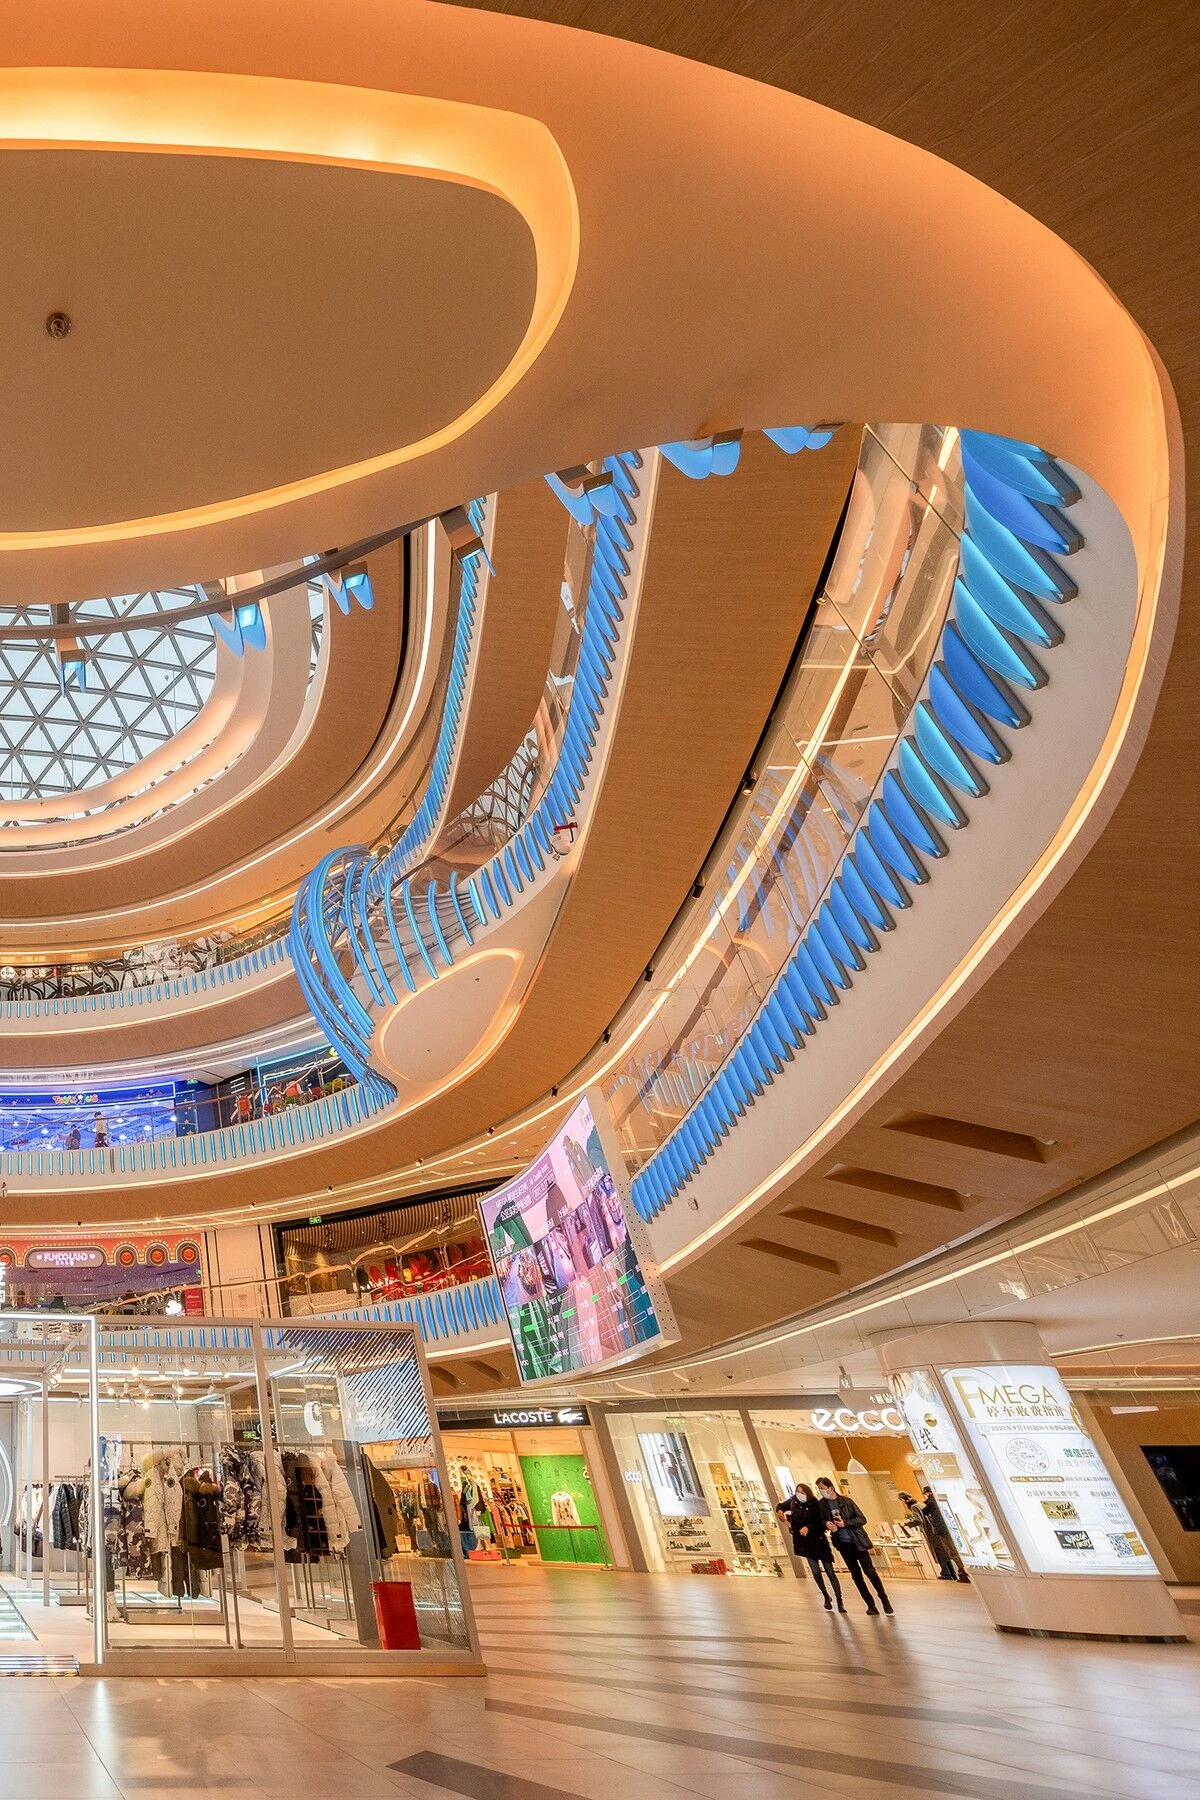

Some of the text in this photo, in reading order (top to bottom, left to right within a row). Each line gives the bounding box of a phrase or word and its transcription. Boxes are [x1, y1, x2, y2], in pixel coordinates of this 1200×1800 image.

[978, 1384, 1058, 1405] MEGA
[494, 1411, 553, 1424] LACOSTE
[811, 1407, 907, 1432] ecco
